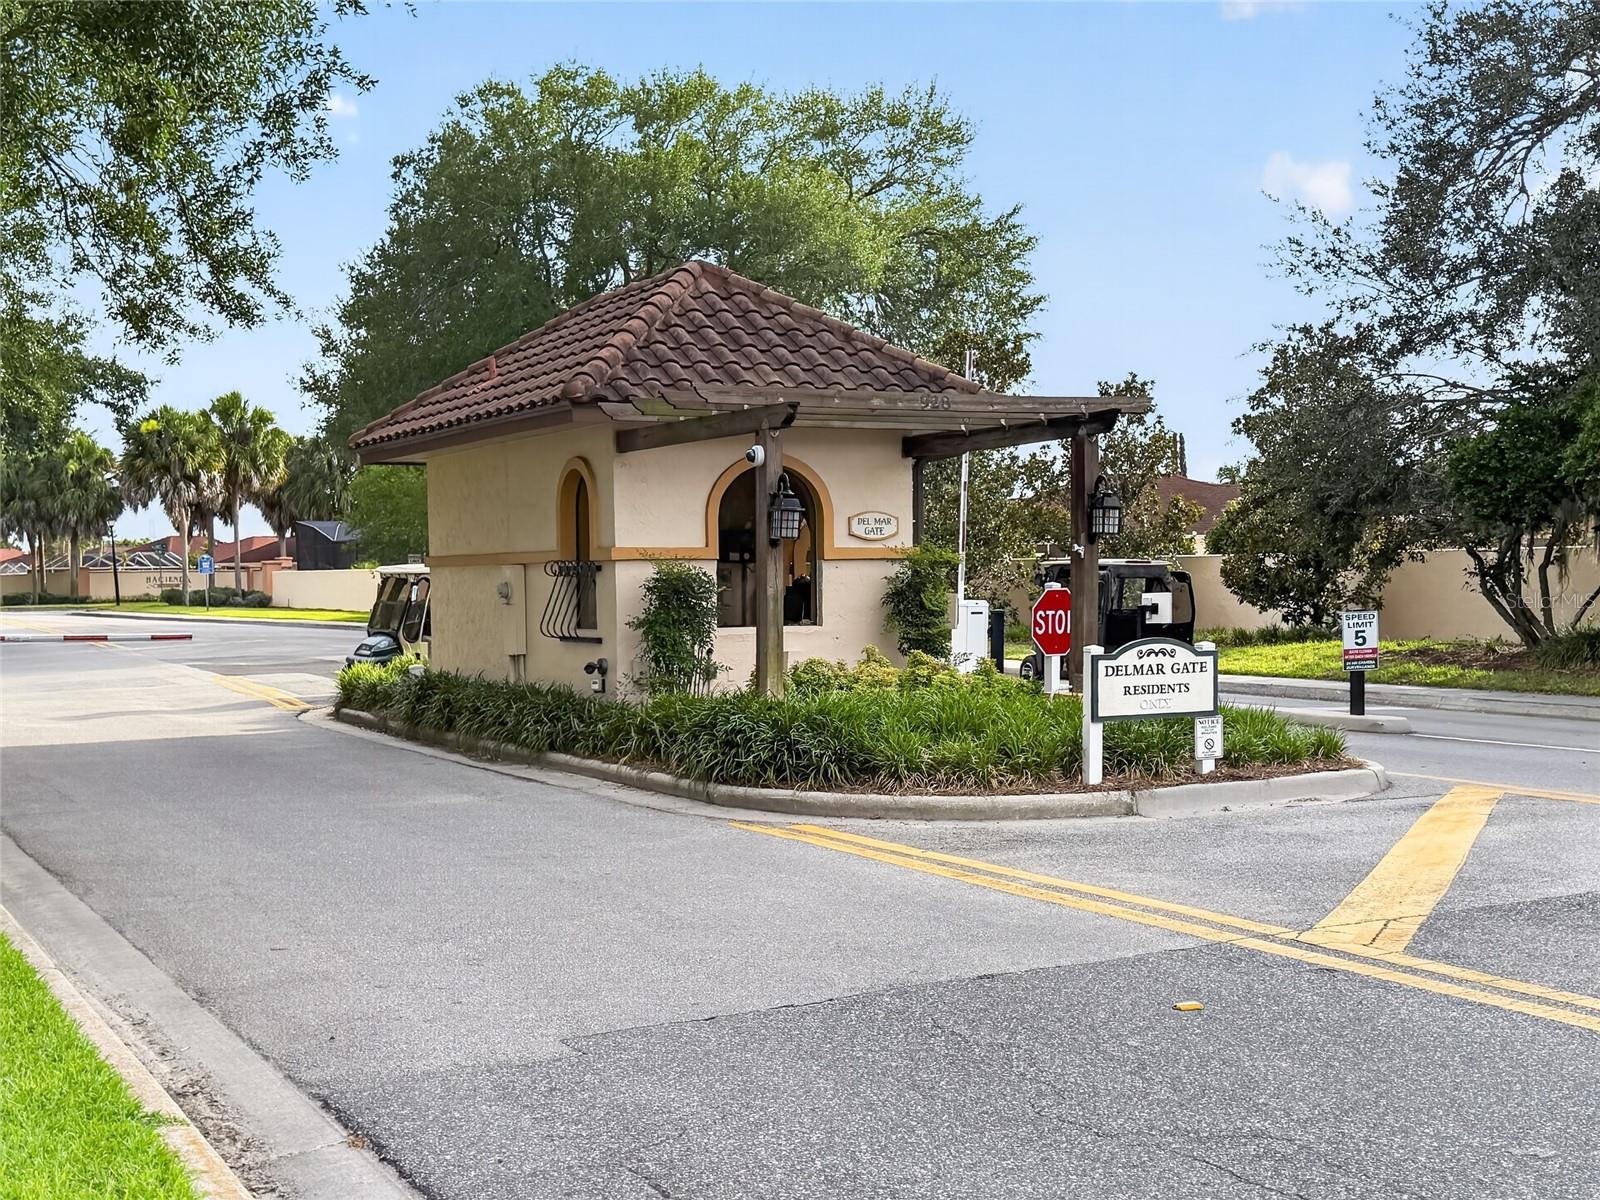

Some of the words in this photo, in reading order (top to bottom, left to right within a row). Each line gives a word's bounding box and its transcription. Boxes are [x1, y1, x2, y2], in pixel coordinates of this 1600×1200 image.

[857, 517, 871, 526] DEL
[874, 517, 892, 526] MAR
[864, 526, 885, 536] GATE
[1345, 613, 1375, 621] SPEED
[1347, 621, 1374, 629] LIMIT
[1354, 630, 1367, 647] 5
[1104, 663, 1166, 677] DELMAR
[1171, 661, 1208, 674] GATE
[1123, 683, 1190, 696] RESIDENTS
[1139, 697, 1172, 710] ONLY
